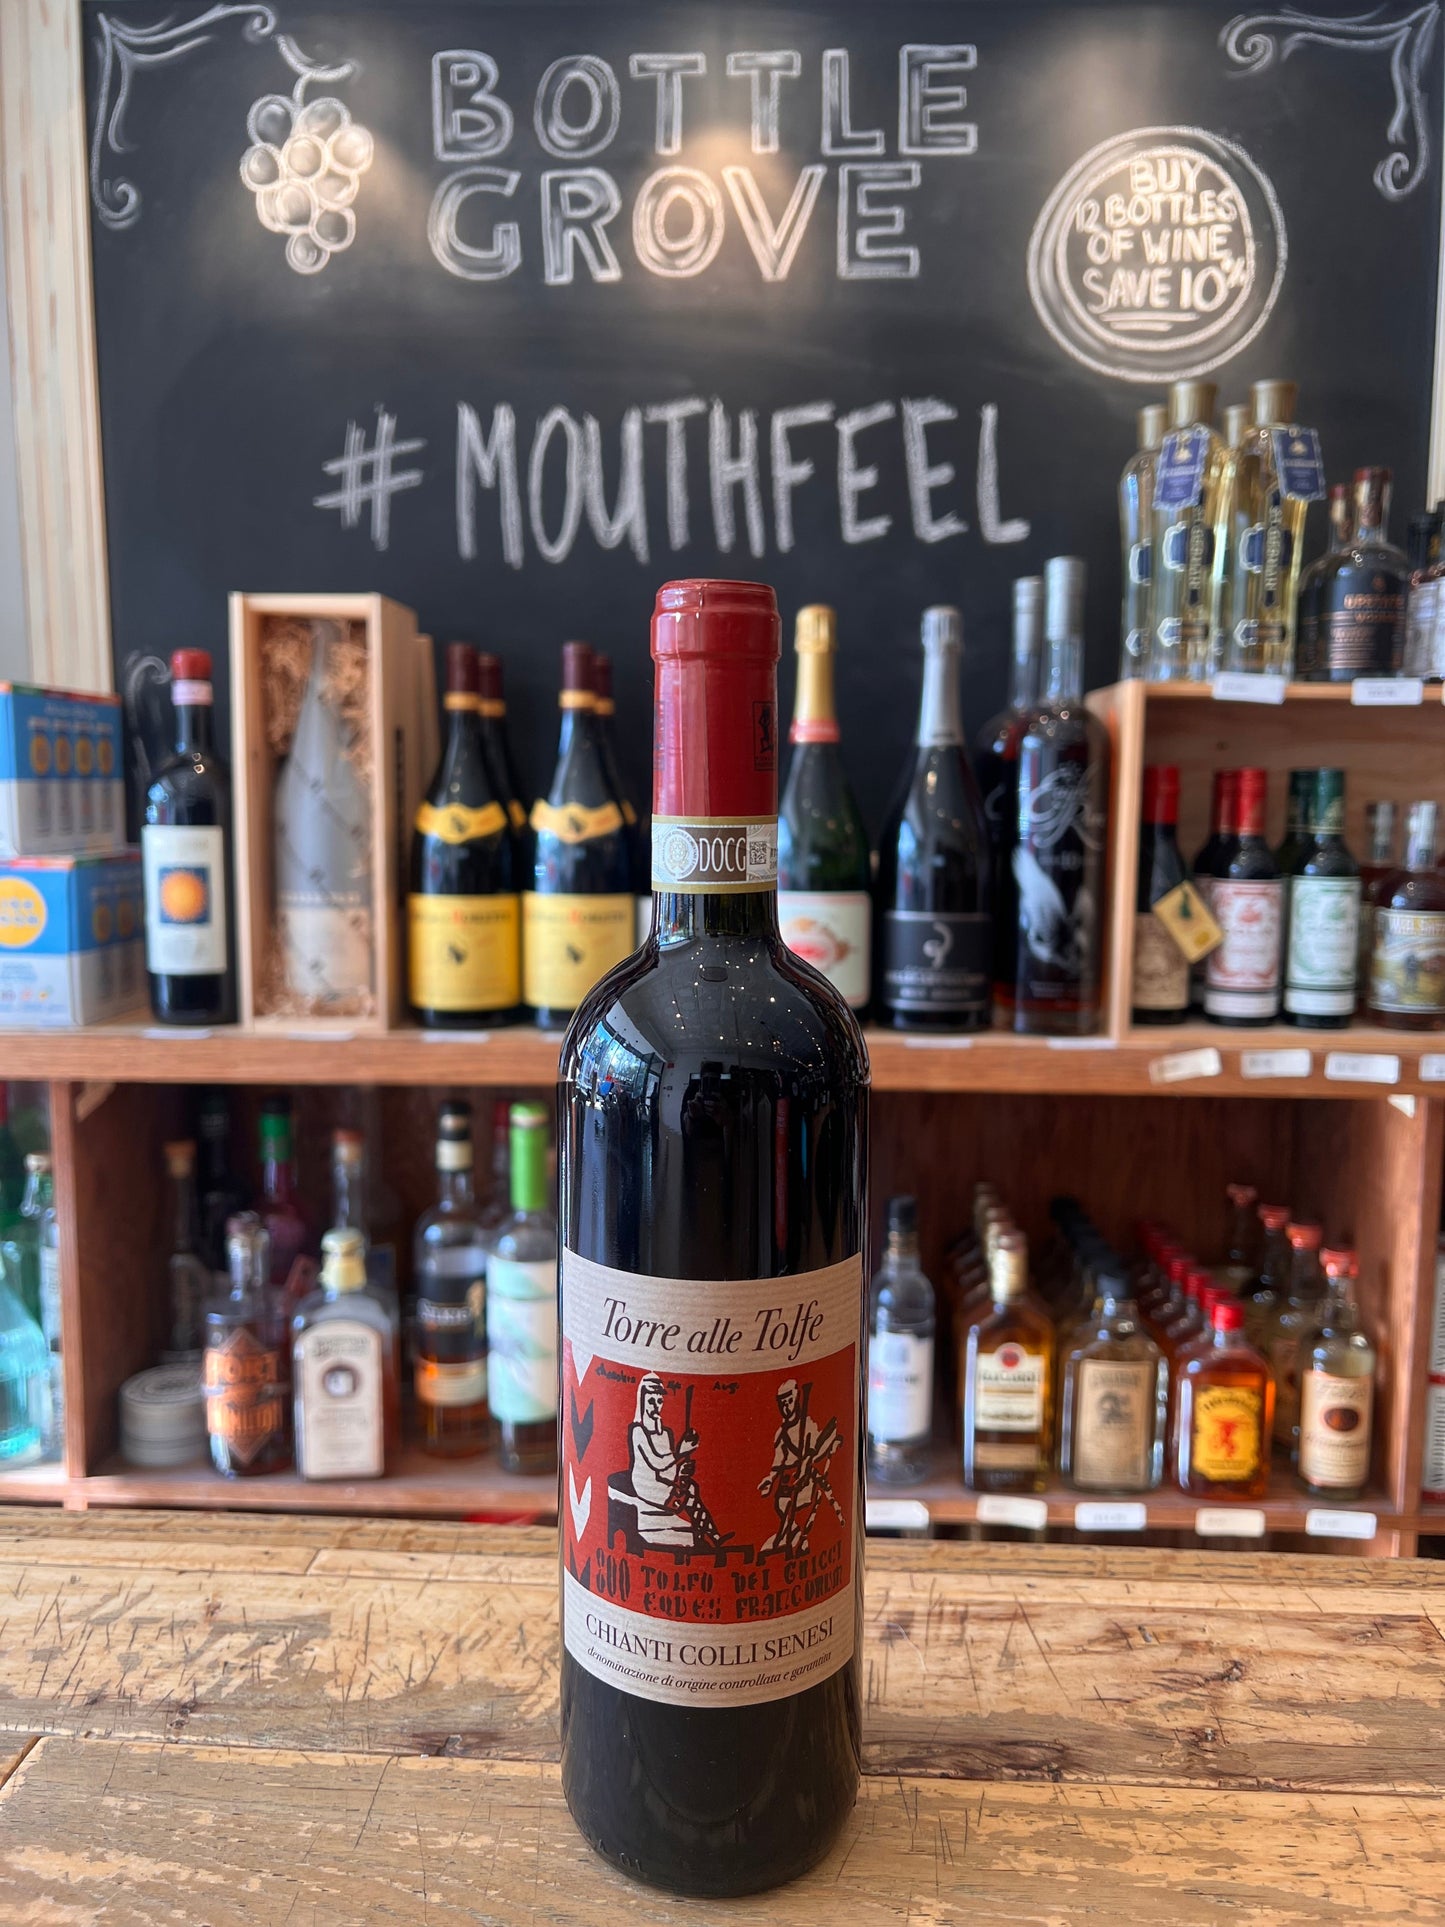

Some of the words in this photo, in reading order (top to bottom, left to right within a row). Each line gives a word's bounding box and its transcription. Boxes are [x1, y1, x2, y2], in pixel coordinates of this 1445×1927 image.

[431, 44, 978, 161] BOTTLE
[1129, 157, 1203, 196] BUY
[427, 162, 922, 285] GROVE
[1075, 198, 1101, 234] 12
[1104, 188, 1238, 228] BOTTLES
[1086, 228, 1134, 265] OF
[1141, 223, 1233, 265] WINE
[1082, 266, 1173, 314] SAVE
[1179, 256, 1248, 312] 10%
[699, 837, 747, 873] DOCG
[601, 1297, 681, 1351] Torre
[687, 1318, 743, 1354] alle
[752, 1299, 824, 1361] Tolfe
[585, 1613, 674, 1663] CHIANTI
[679, 1642, 759, 1667] COLLI
[763, 1616, 834, 1661] SENESI
[587, 1646, 660, 1684] denominazione
[661, 1674, 673, 1687] di
[675, 1678, 718, 1693] origine
[718, 1673, 782, 1690] controllata
[782, 1671, 790, 1680] e
[789, 1652, 832, 1681] garantita
